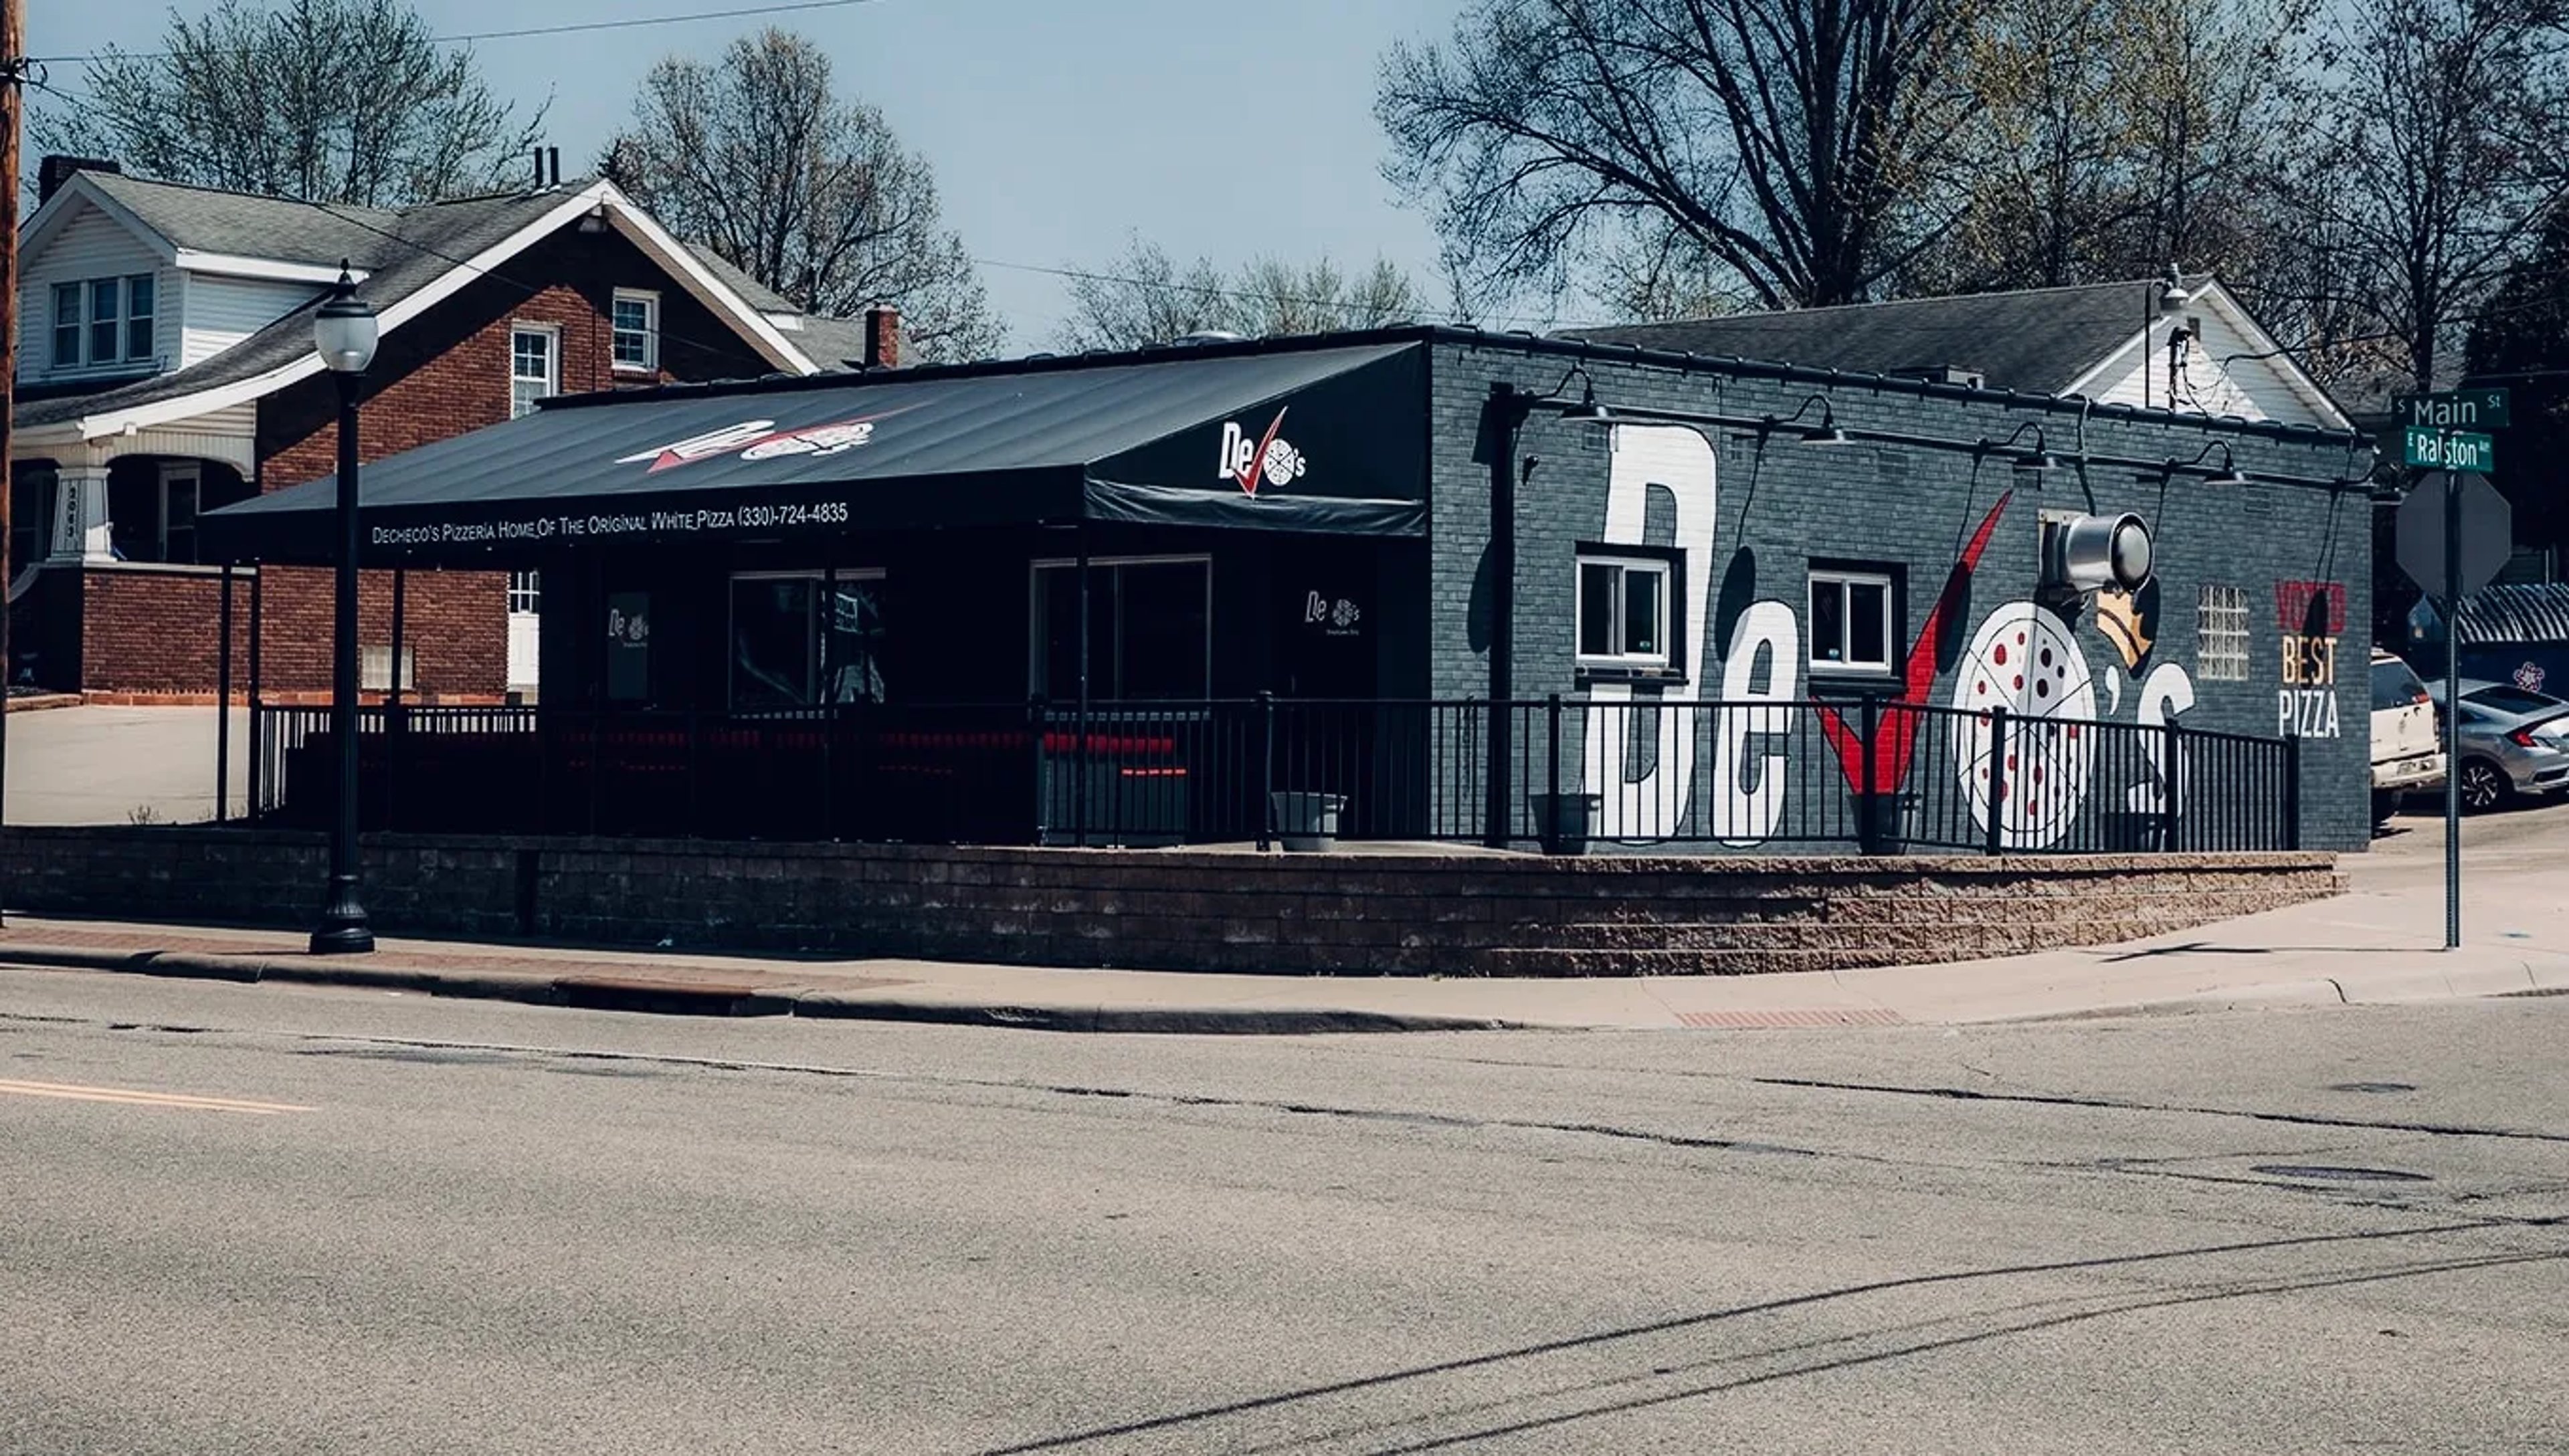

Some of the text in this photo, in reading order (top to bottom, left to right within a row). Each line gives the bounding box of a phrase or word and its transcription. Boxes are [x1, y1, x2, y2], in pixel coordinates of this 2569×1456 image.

[2397, 394, 2501, 425] S Main St
[2416, 433, 2477, 466] Ralston
[499, 520, 537, 538] HOME
[537, 517, 555, 536] OF
[559, 516, 585, 535] THE
[2275, 580, 2346, 632] VOTD
[2282, 634, 2338, 685] BEST
[2279, 689, 2340, 738] PIZZA
